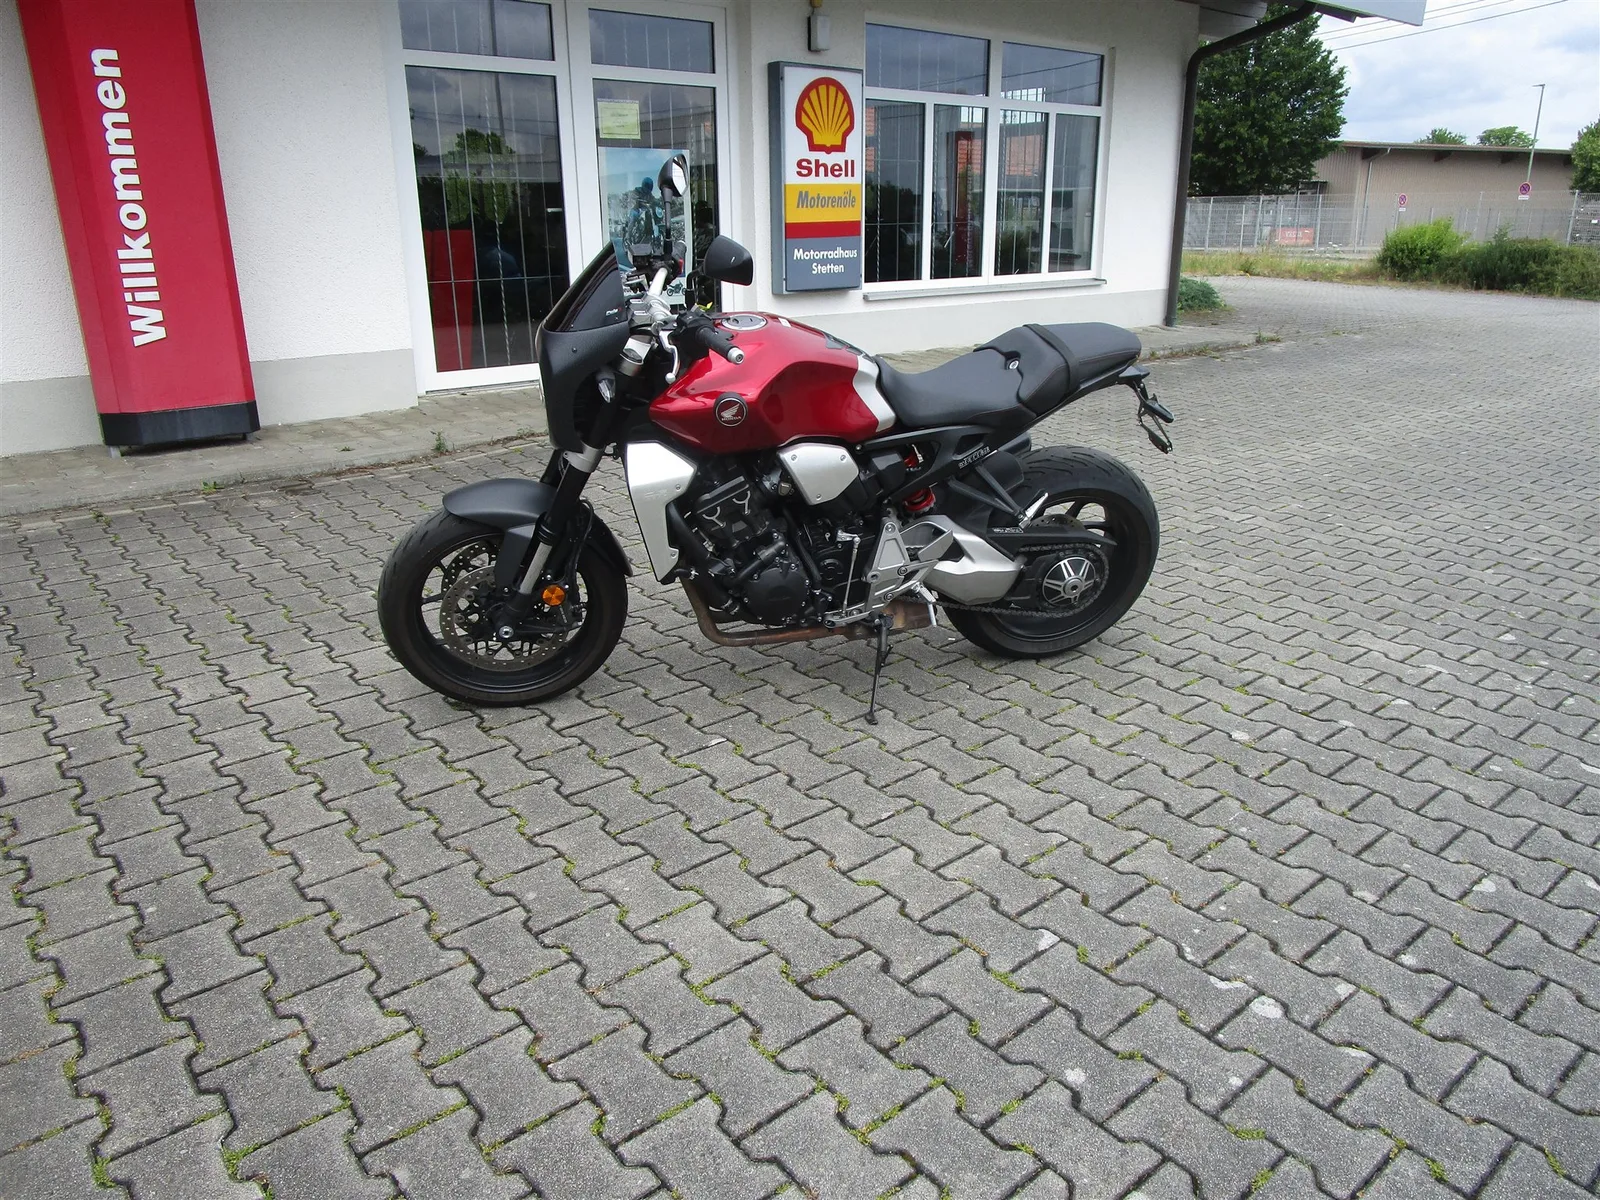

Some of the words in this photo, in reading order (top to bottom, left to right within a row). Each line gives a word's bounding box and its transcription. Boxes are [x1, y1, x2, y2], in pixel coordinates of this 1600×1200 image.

[796, 158, 855, 178] Shell
[90, 48, 167, 347] Willkommen
[796, 189, 857, 209] Motorenöle
[793, 246, 858, 261] Motorradhaus
[811, 262, 845, 275] Stetten
